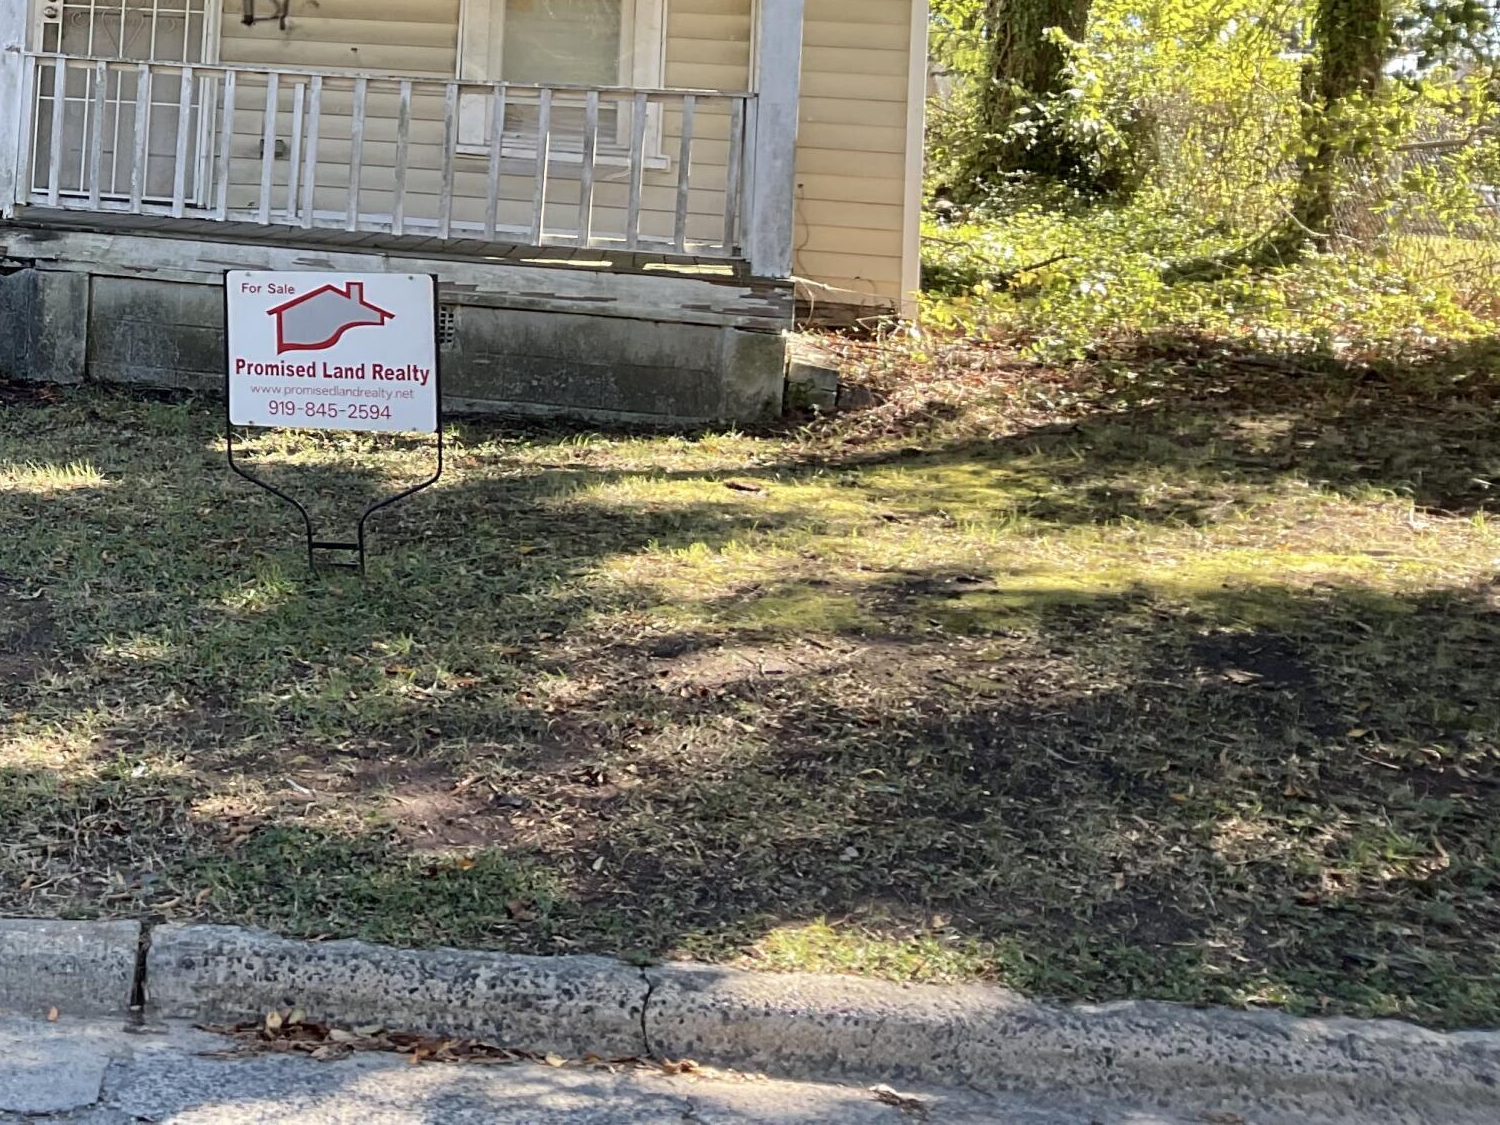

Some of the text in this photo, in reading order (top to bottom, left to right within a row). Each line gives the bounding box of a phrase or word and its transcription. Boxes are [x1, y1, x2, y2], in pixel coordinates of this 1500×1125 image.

[241, 282, 296, 295] For Sale
[235, 358, 430, 386] Promised Land Realty
[250, 385, 415, 400] www.promisedlandrealty.net
[268, 400, 392, 420] 919-845-2594
